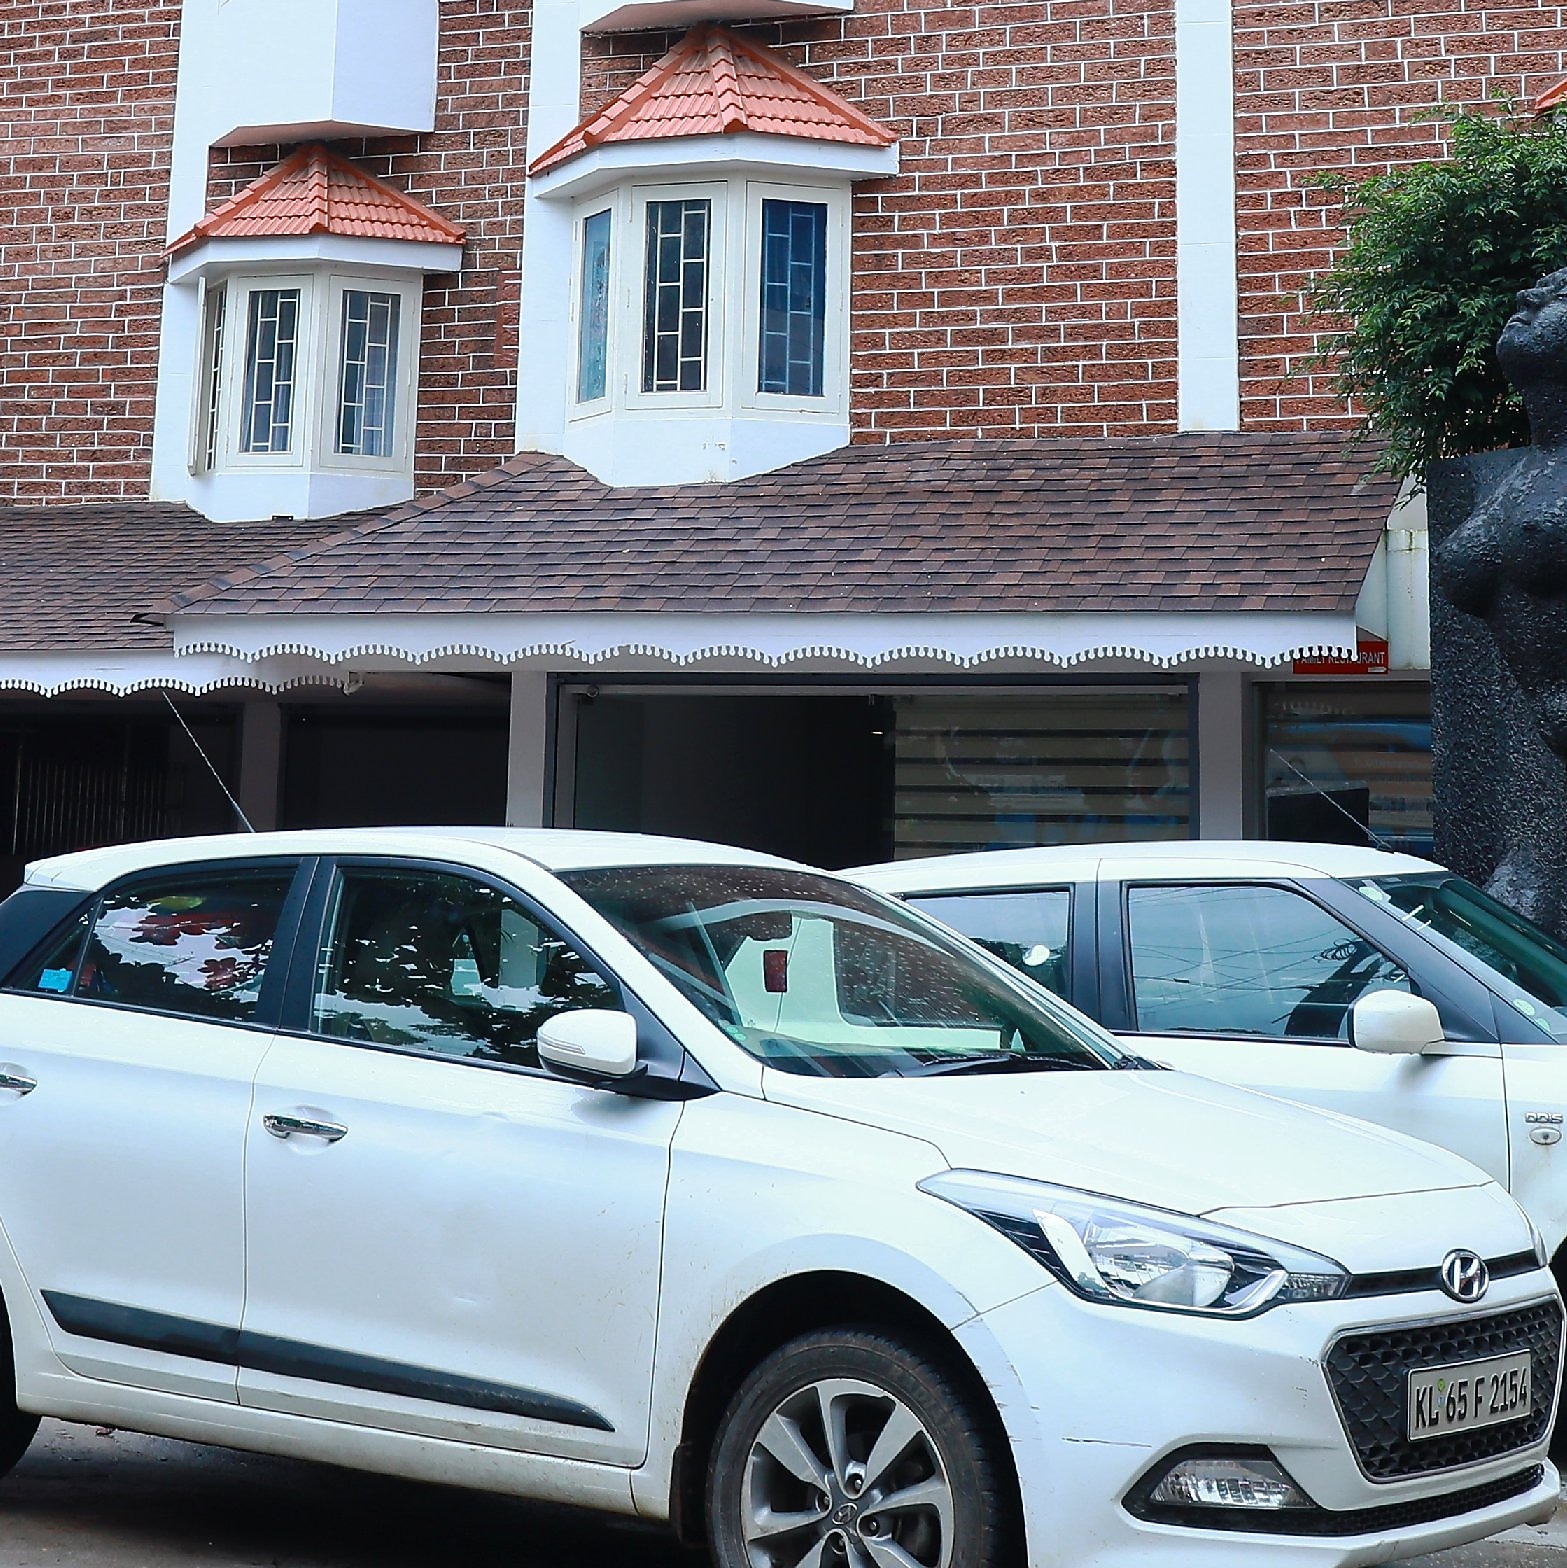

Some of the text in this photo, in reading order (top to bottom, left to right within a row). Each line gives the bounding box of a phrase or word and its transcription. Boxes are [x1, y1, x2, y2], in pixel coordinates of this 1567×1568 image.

[1415, 1367, 1528, 1429] KL 65 F 2154
